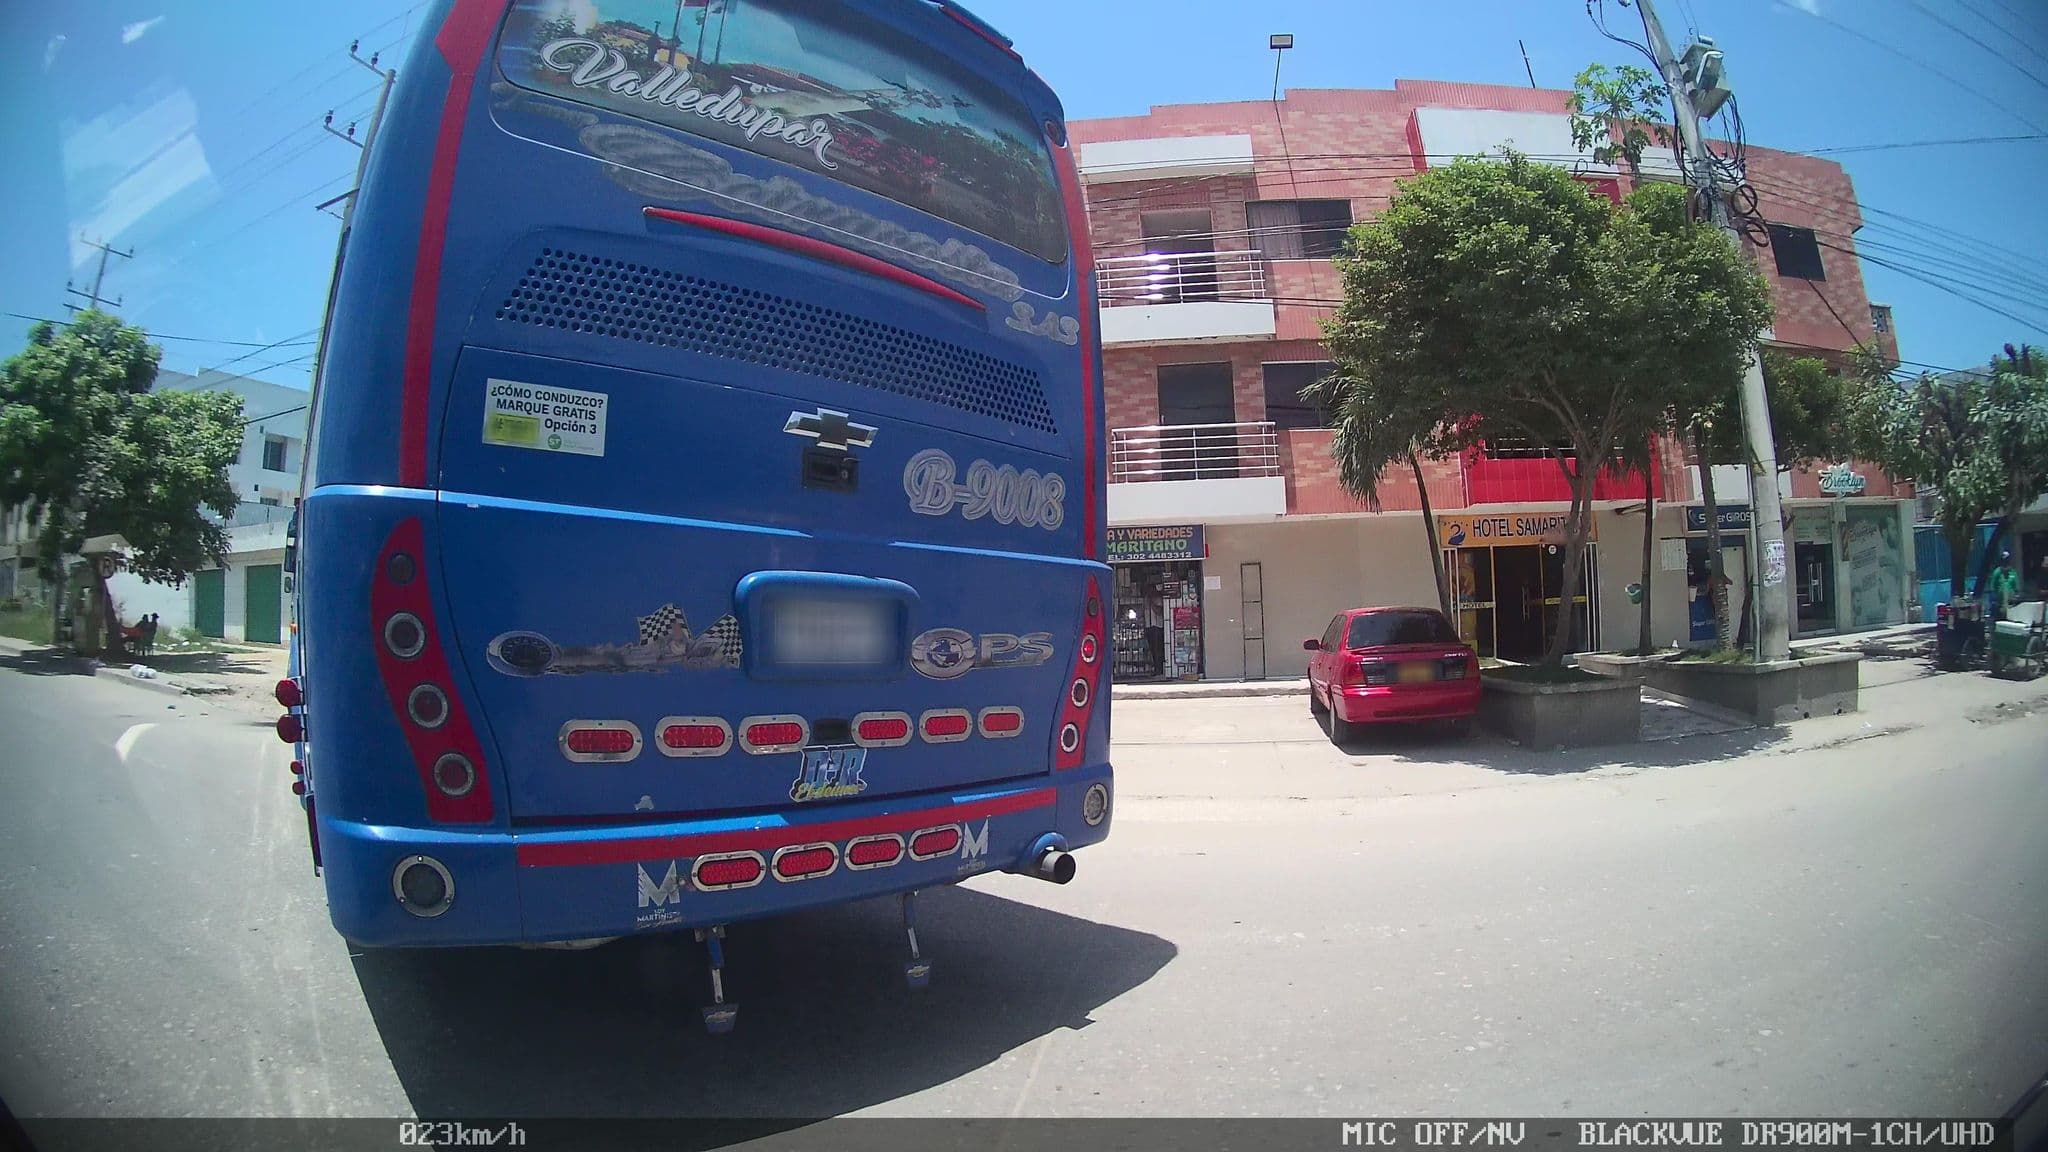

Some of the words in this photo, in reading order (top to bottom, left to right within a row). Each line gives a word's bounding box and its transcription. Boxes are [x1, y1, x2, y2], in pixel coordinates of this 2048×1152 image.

[541, 38, 837, 169] Valledupar
[491, 384, 532, 399] ¿CÓMO
[535, 390, 604, 408] CONDUZCO?
[496, 398, 549, 415] MARQUE
[552, 405, 596, 420] GRATIS
[544, 418, 586, 433] Opción
[589, 424, 597, 434] 3
[903, 448, 1066, 531] B-9008
[1117, 530, 1125, 540] Y
[1127, 527, 1193, 540] VARIEDADES
[1472, 518, 1514, 537] HOTEL
